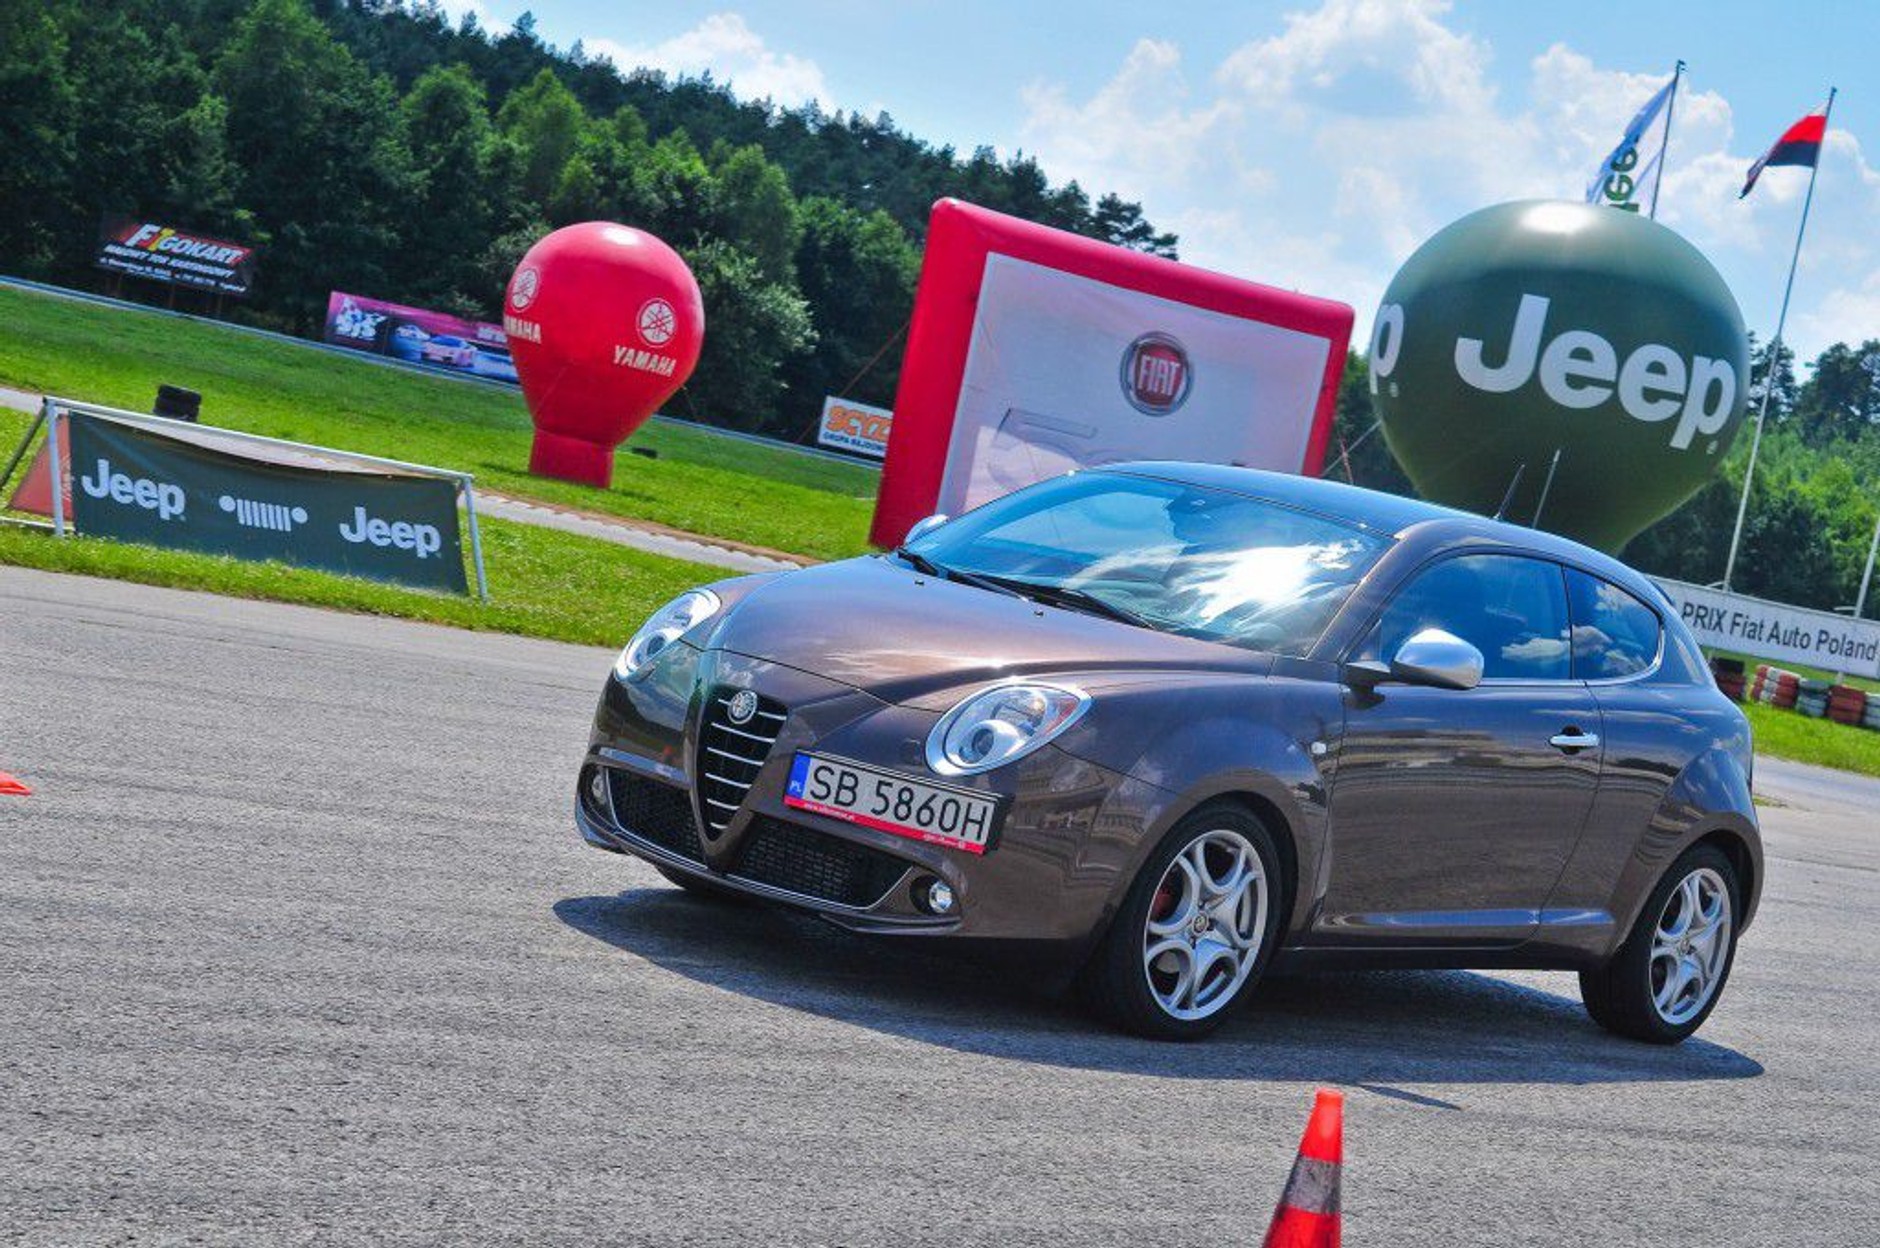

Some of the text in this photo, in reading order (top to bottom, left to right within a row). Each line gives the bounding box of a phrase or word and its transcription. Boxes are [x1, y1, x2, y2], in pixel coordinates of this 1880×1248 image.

[613, 344, 677, 377] YAMAHA
[1137, 355, 1180, 396] FIAT
[1454, 293, 1736, 450] Jeep
[81, 458, 185, 520] Jeep
[339, 506, 440, 558] Jeep
[1681, 602, 1879, 661] PRIX Fiat Auto Poland
[809, 765, 988, 840] SB 5860H
